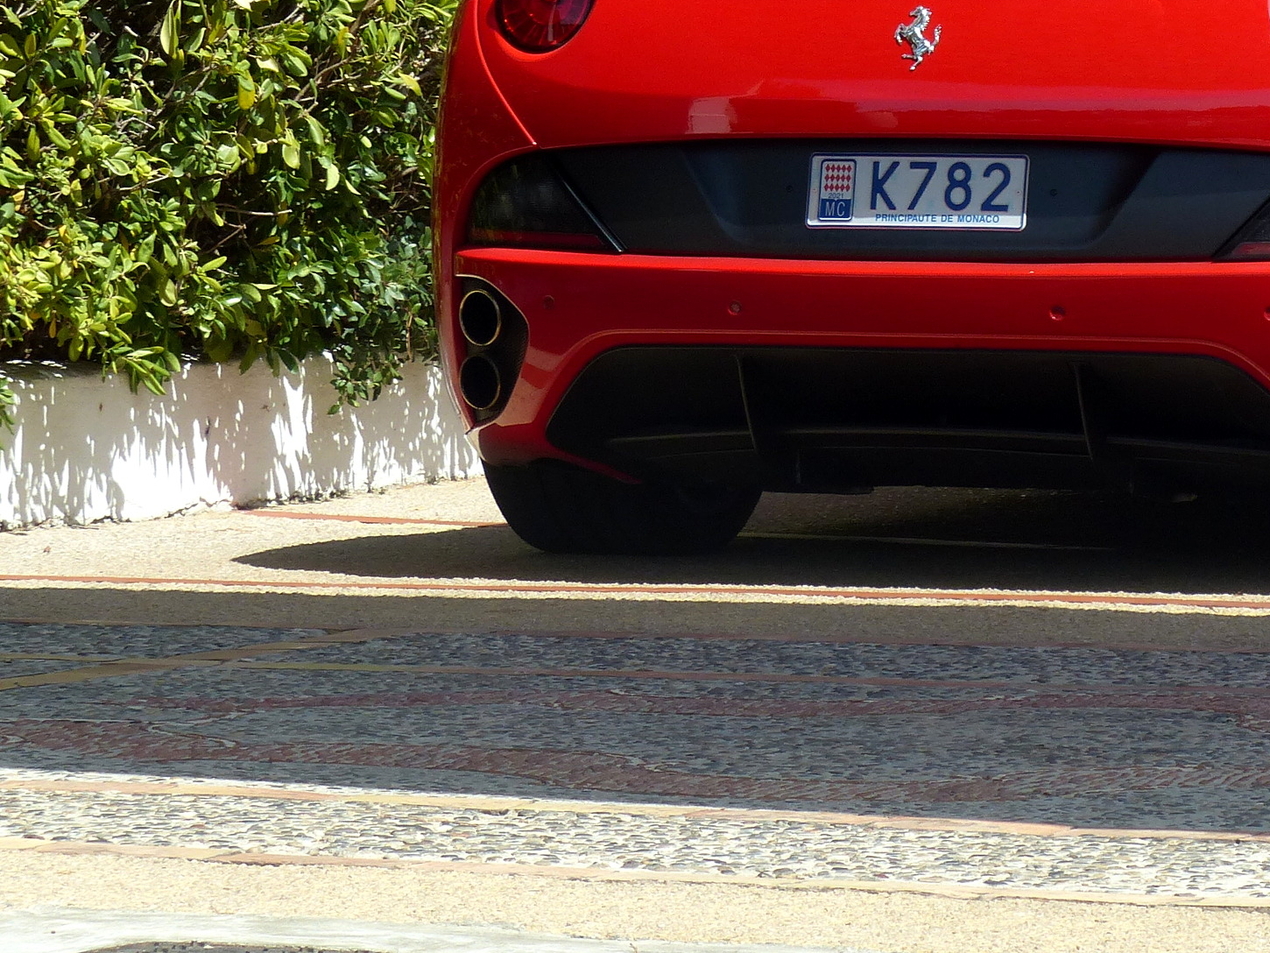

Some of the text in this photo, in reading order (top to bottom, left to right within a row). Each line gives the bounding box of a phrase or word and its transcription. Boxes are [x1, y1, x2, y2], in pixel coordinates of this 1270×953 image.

[869, 161, 1011, 212] K782
[825, 201, 846, 217] MC
[875, 213, 1000, 224] PRINCIPAUTE DE MONACO
